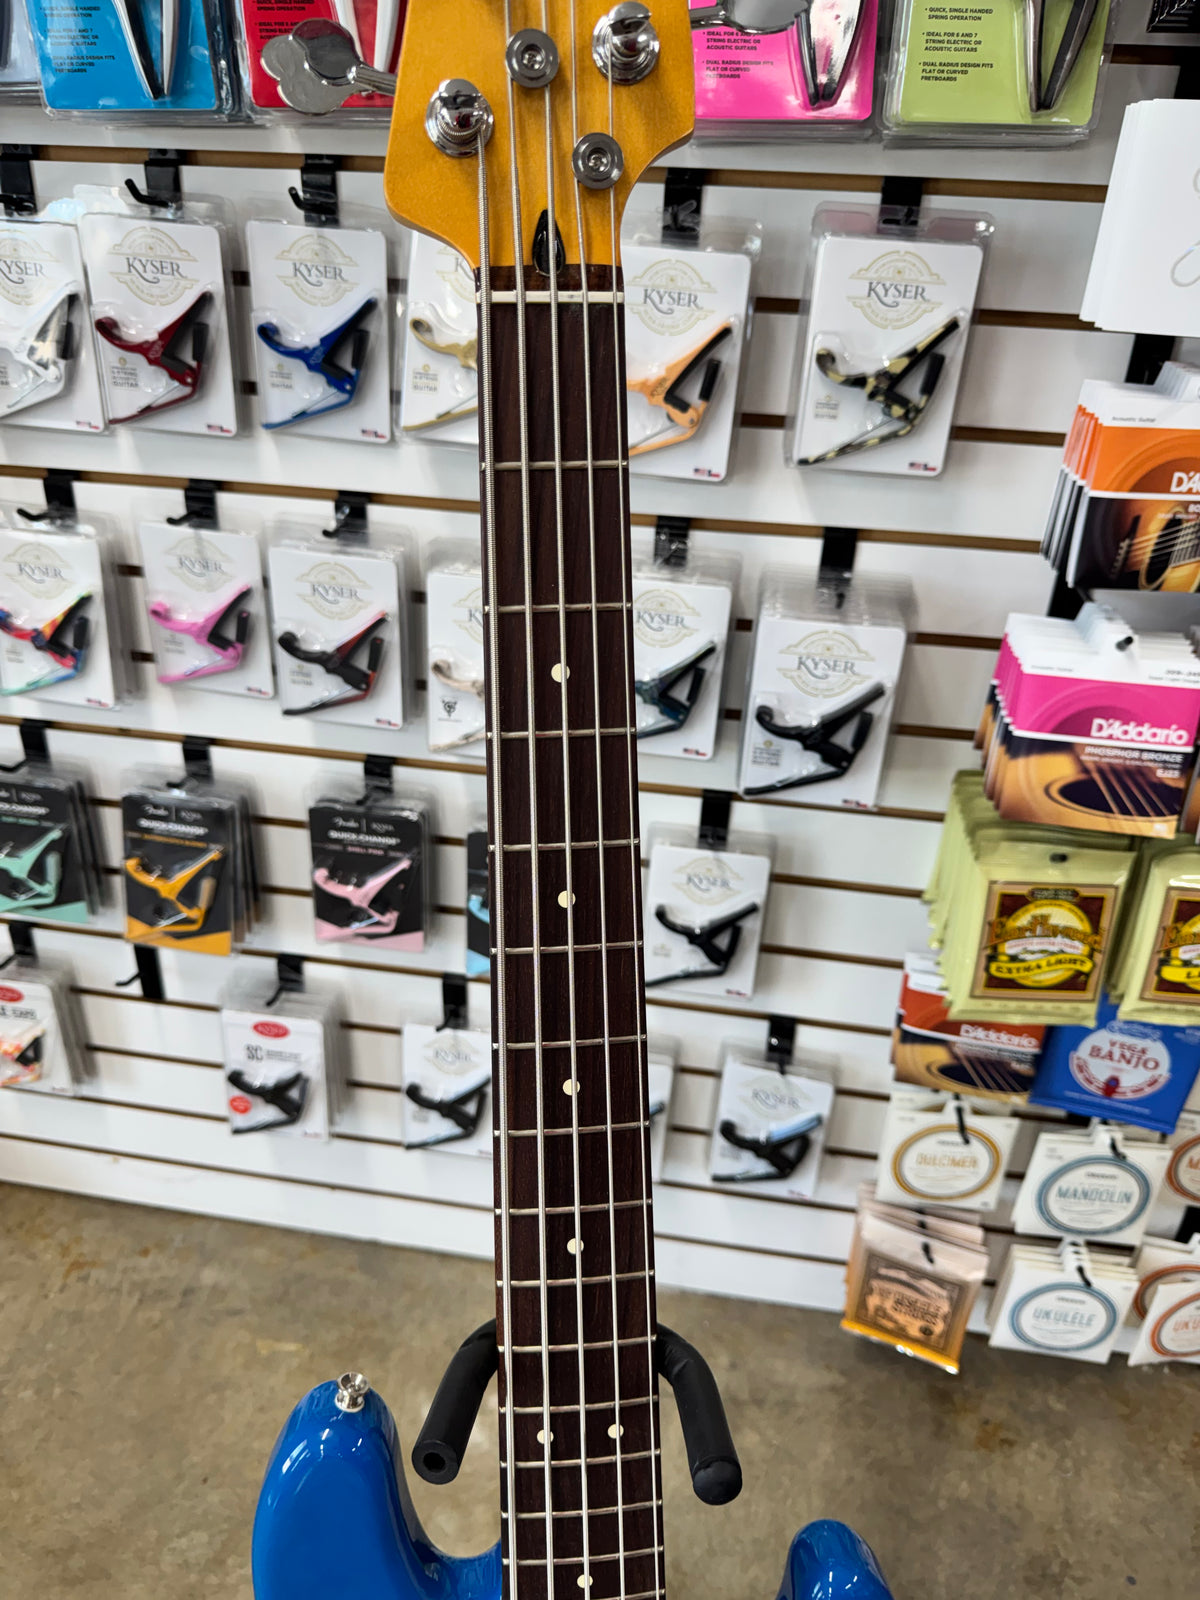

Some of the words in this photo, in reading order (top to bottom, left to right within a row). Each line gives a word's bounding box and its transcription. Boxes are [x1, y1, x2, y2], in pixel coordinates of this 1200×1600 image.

[126, 257, 188, 284] KYSER
[292, 262, 349, 287] KYSER
[643, 288, 704, 315] KYSER
[867, 281, 931, 308] KYSER
[17, 562, 65, 584] KYSER
[178, 556, 225, 578] KYSER
[312, 584, 361, 605] KYSER
[636, 610, 687, 632] KYSER
[797, 655, 858, 680] KYSER
[1090, 718, 1188, 745] D'Addario
[1089, 1045, 1159, 1071] BANJO
[1109, 1039, 1148, 1055] VEGA
[1056, 1186, 1132, 1203] MANDOLIN
